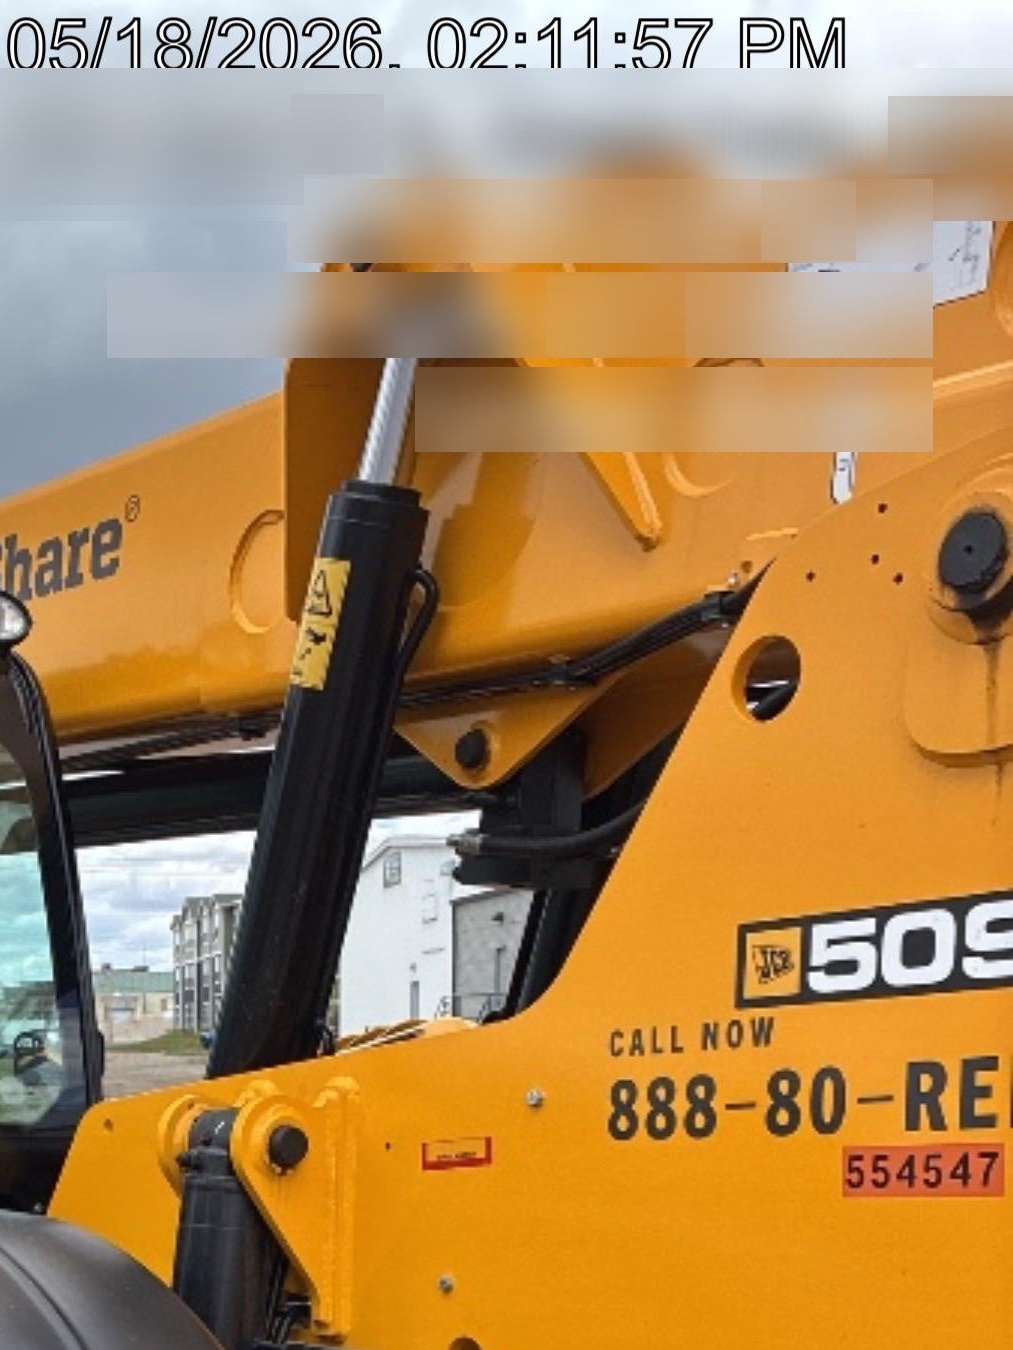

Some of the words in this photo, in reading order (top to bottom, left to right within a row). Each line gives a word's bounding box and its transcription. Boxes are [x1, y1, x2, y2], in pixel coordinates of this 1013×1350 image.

[807, 899, 1013, 994] 509
[609, 1025, 685, 1056] CALL
[701, 1016, 775, 1050] NOW
[608, 1055, 1013, 1140] 888-80-RE
[845, 1152, 999, 1189] 554547
